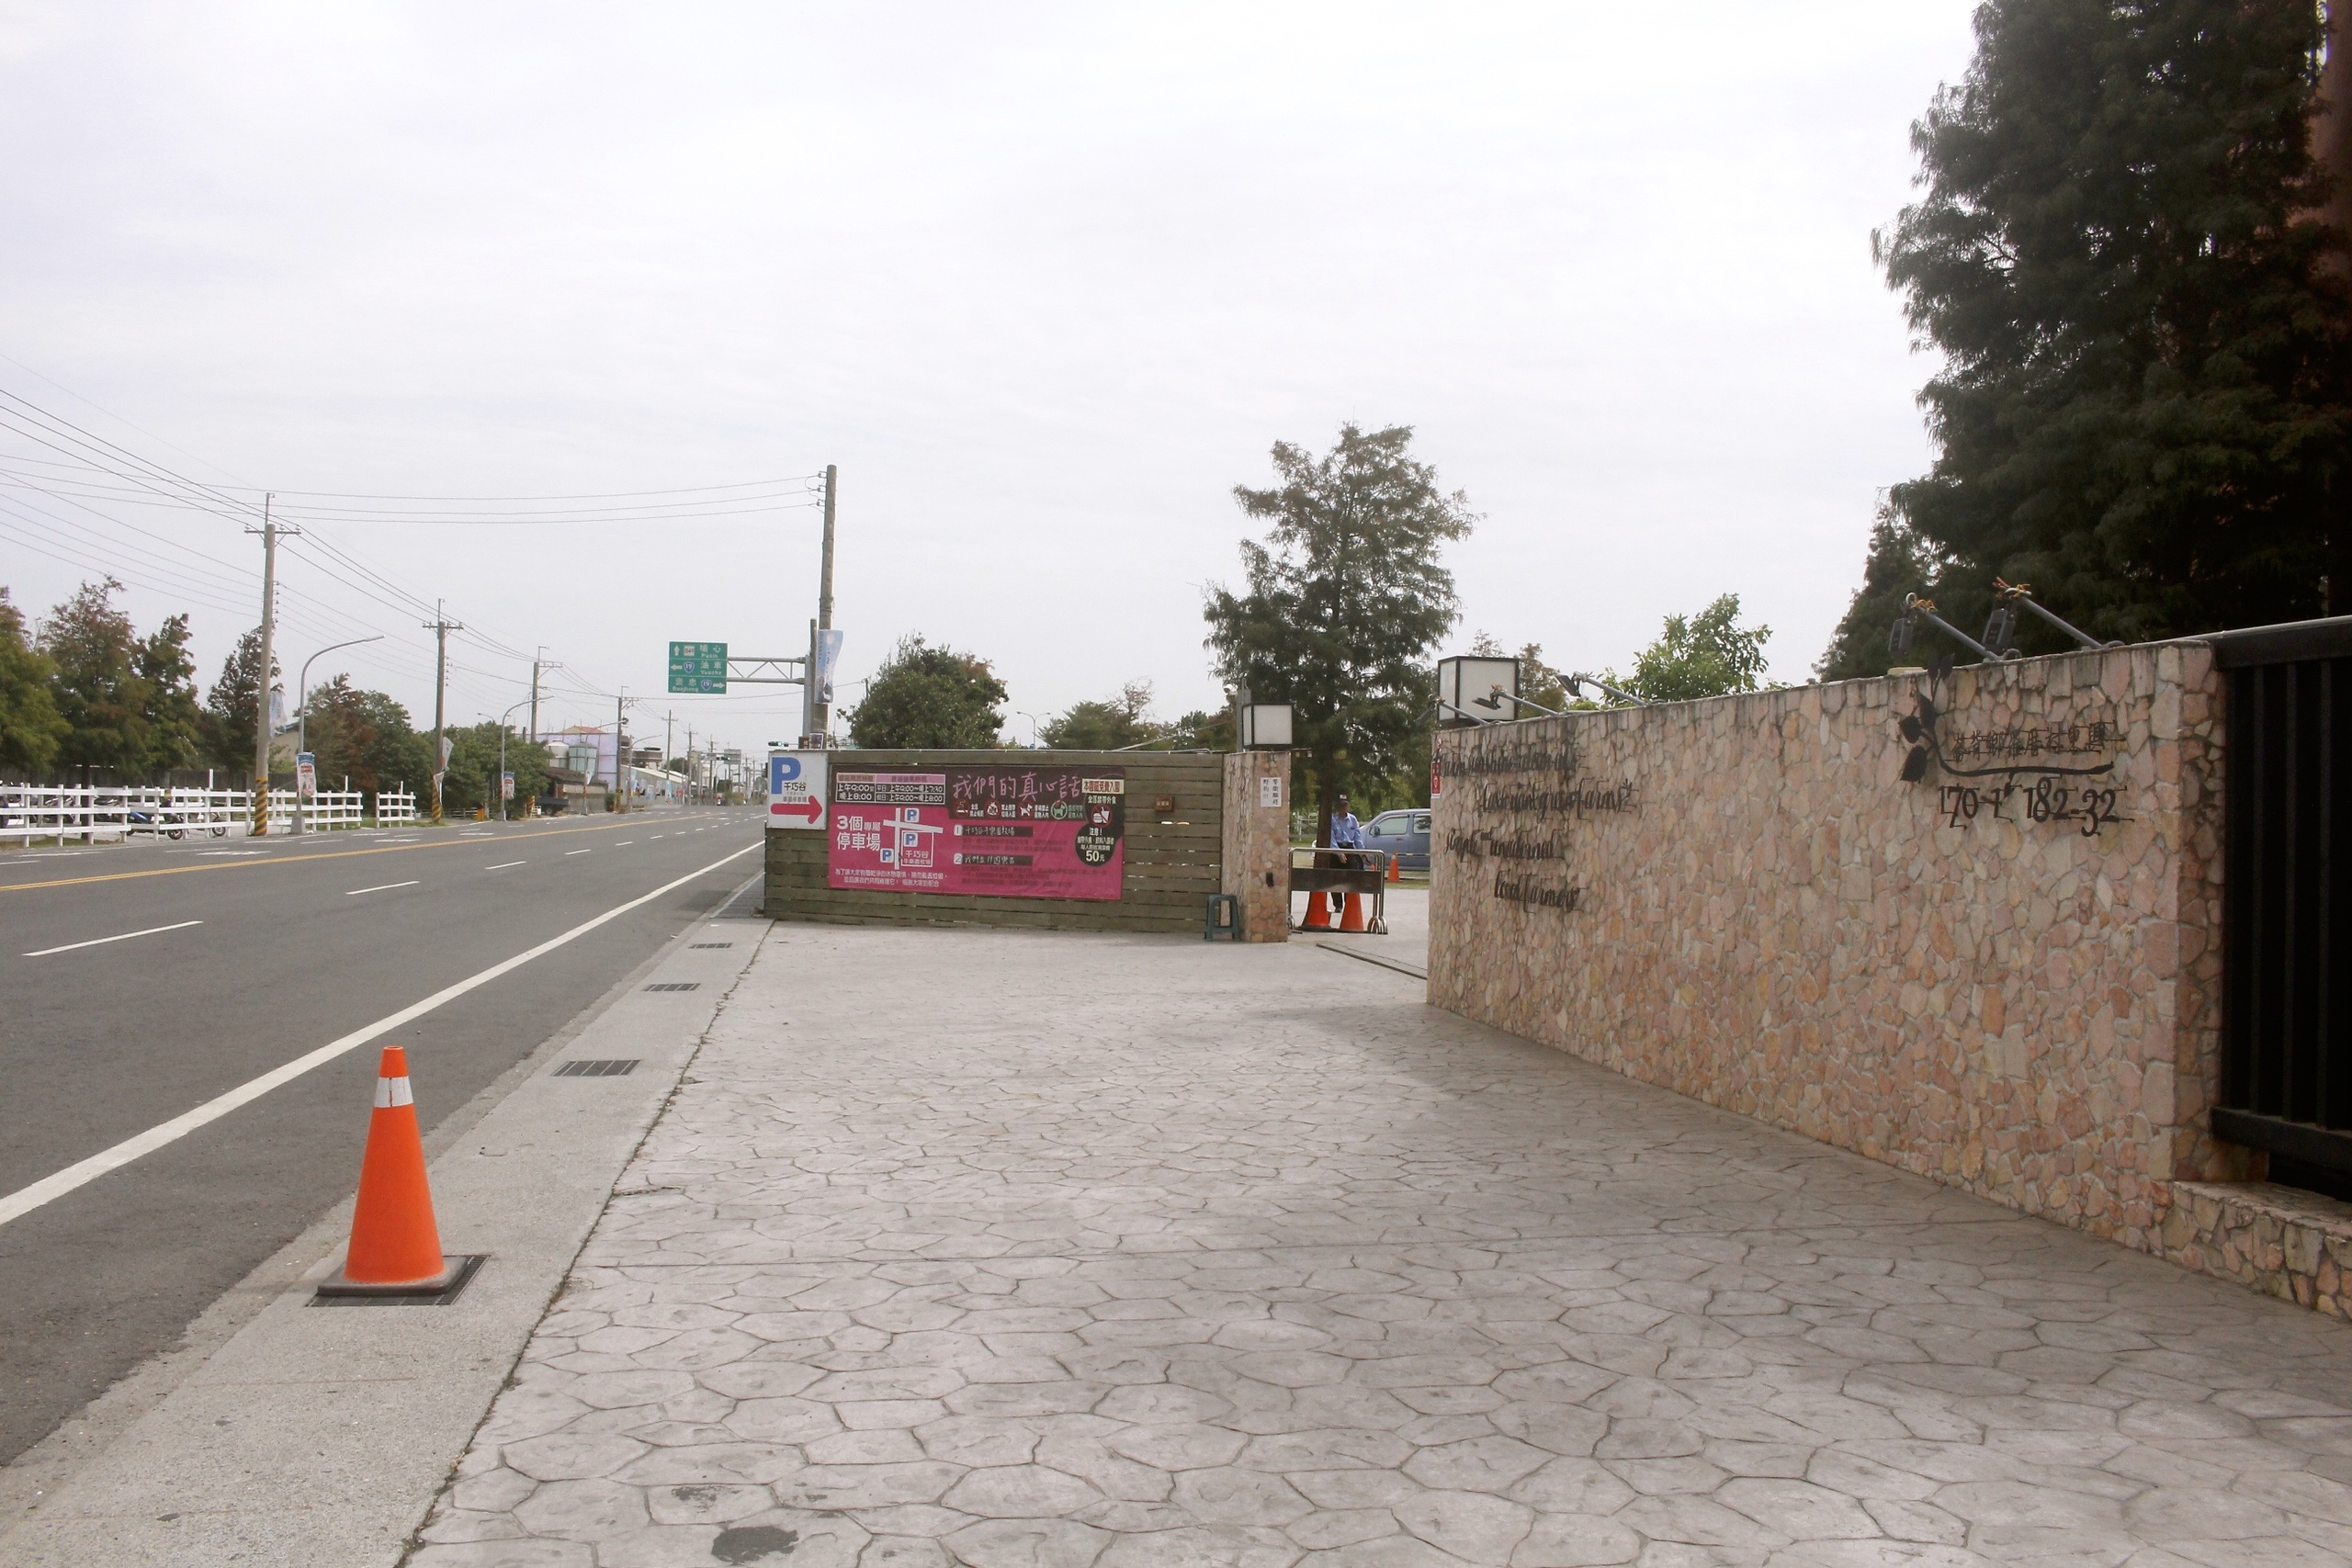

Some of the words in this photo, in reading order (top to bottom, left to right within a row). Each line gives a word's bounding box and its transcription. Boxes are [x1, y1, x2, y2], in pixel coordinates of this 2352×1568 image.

[771, 757, 801, 795] P
[784, 782, 807, 792] 千巧谷
[953, 772, 1080, 802] 我們的真心話
[907, 809, 918, 821] P
[837, 832, 881, 852] 停車場
[905, 833, 916, 845] P
[882, 850, 892, 862] P
[905, 850, 929, 859] 千巧谷
